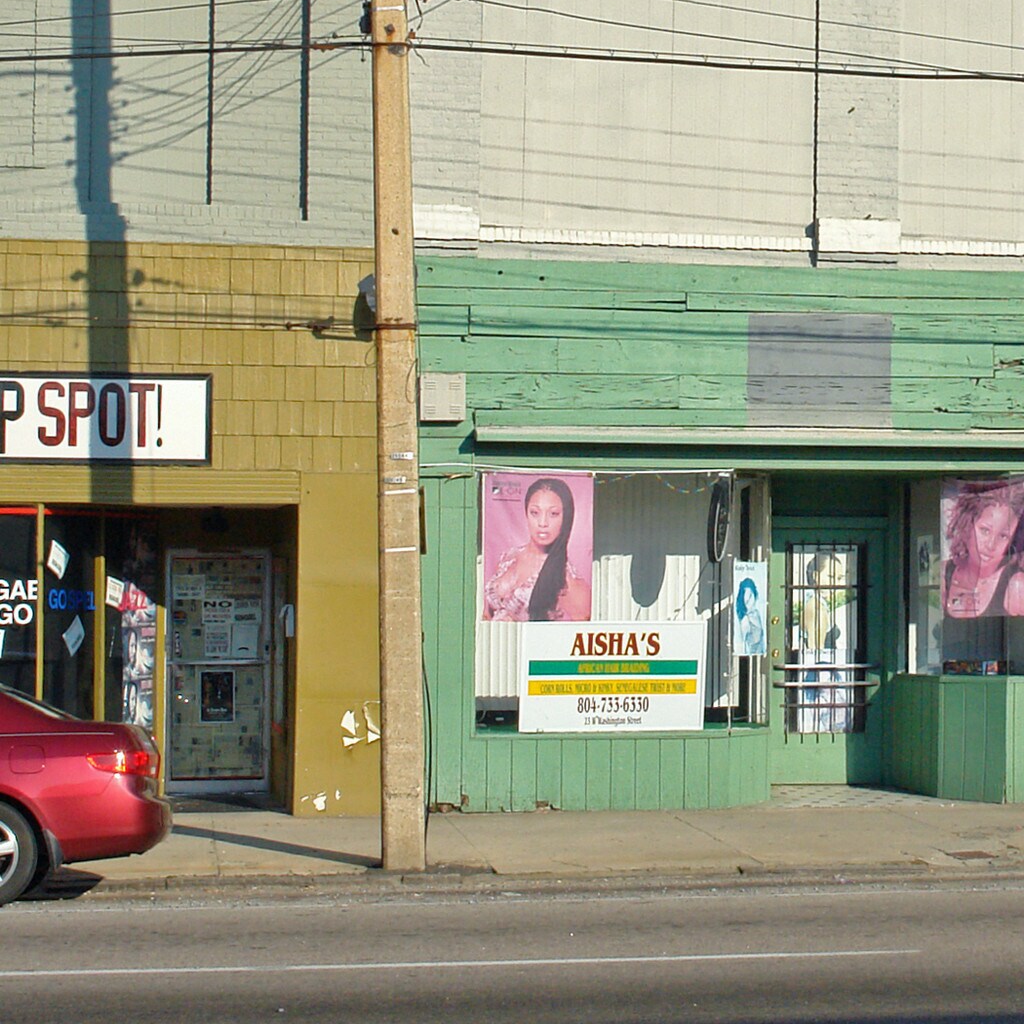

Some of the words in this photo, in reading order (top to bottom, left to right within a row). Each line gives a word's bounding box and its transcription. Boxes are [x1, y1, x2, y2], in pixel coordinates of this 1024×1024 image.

[38, 381, 163, 448] SPOT!
[48, 589, 96, 611] GOSPEL
[0, 603, 33, 625] GO
[570, 632, 661, 657] AISHA'S
[577, 696, 650, 714] 804-733-6330
